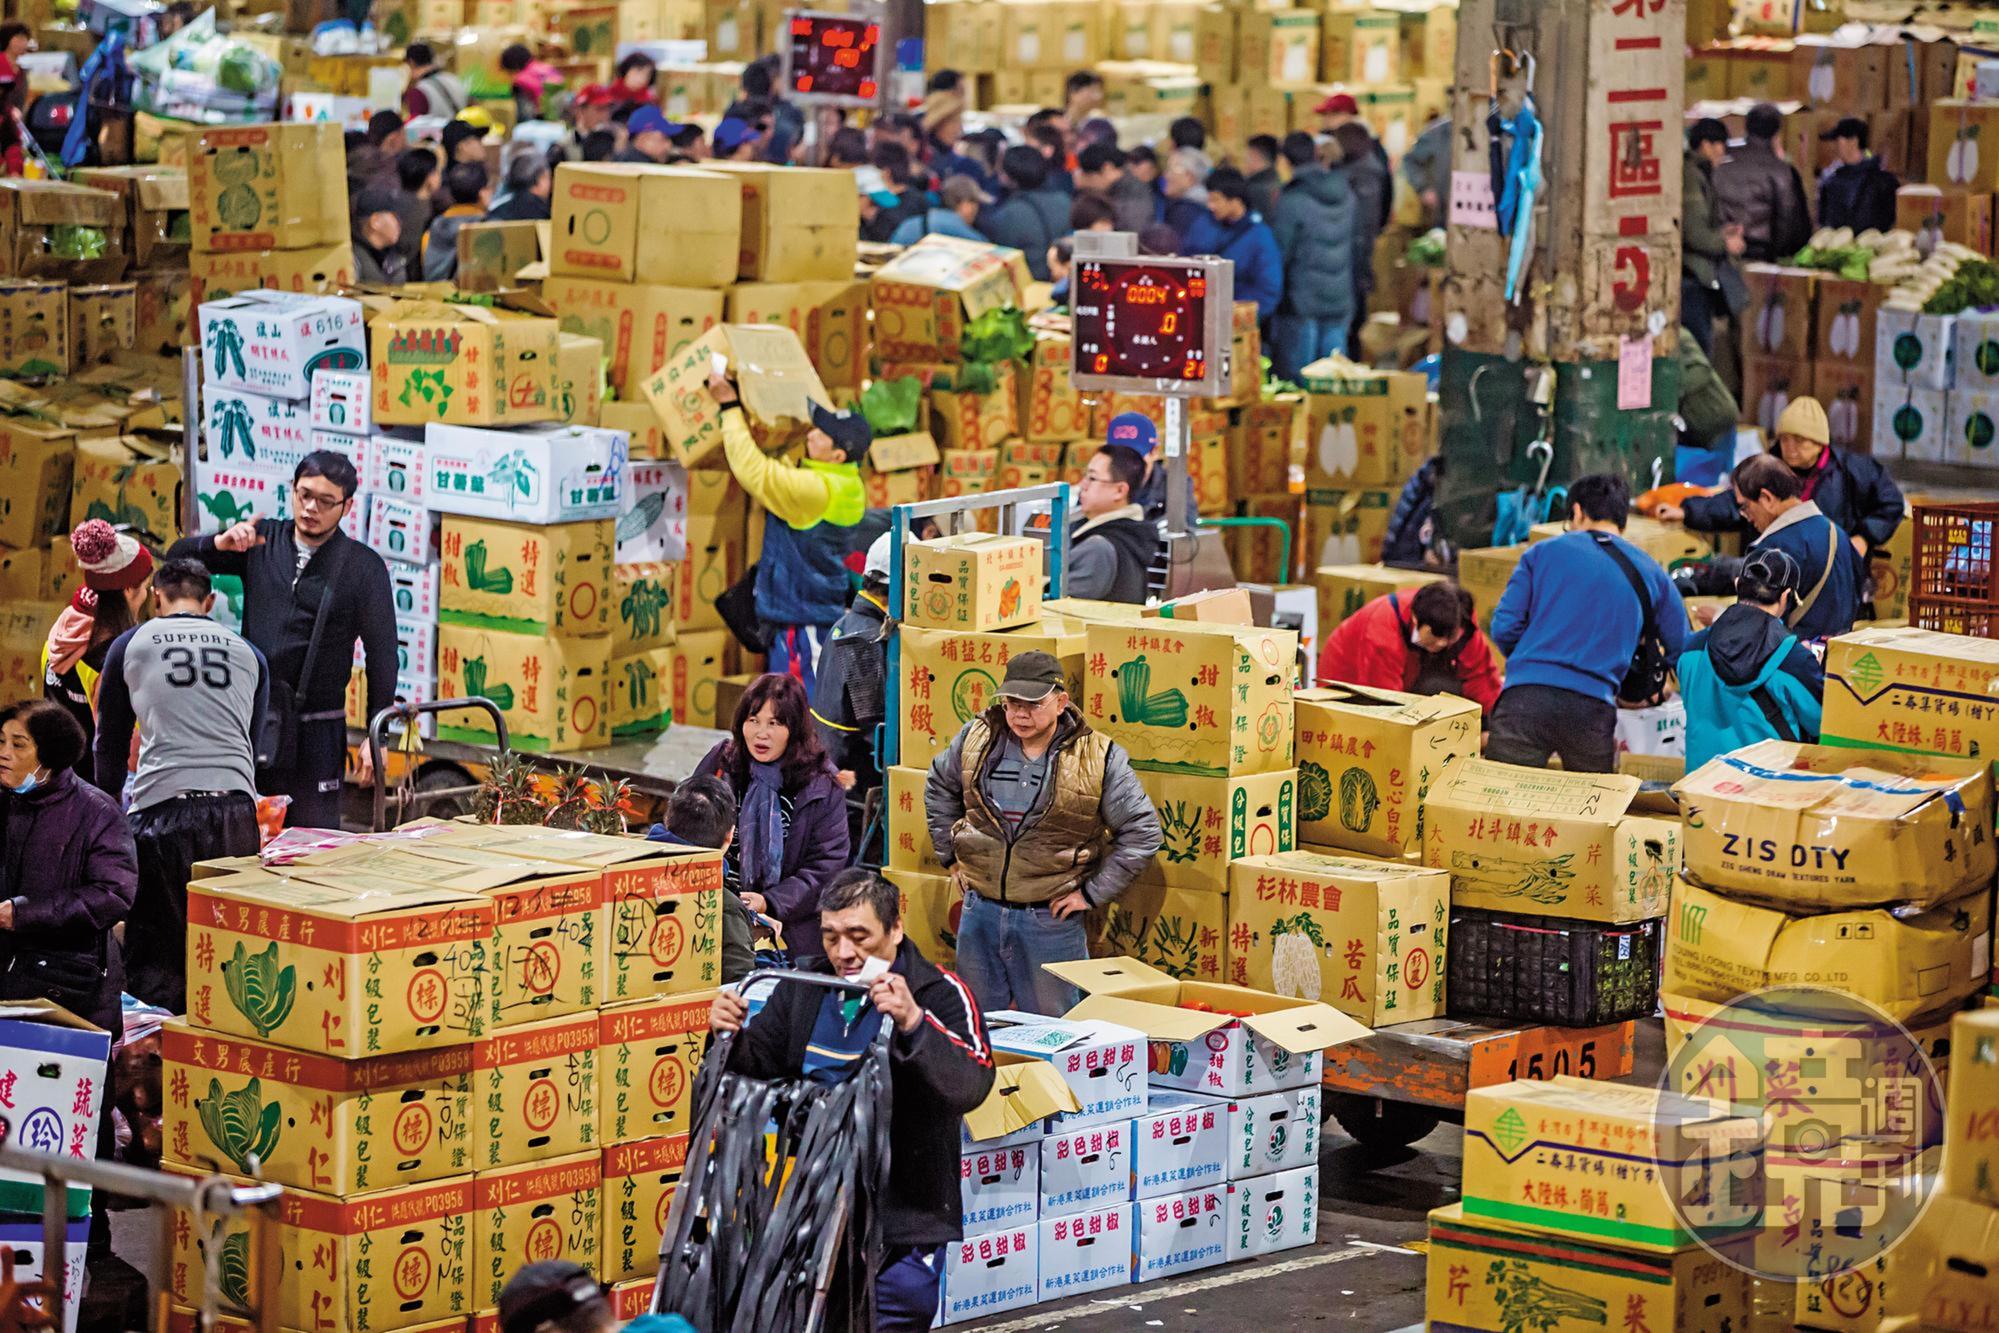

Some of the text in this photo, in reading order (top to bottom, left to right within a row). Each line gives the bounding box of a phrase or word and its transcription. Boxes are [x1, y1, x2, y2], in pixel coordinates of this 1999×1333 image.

[316, 314, 343, 335] 616
[152, 632, 232, 646] SUPPORT
[161, 646, 233, 691] 35
[1088, 652, 1109, 720] 特選
[1196, 662, 1221, 730] 甜椒
[910, 663, 937, 737] 精緻
[1301, 729, 1378, 761] 田中鎮農會
[1203, 805, 1224, 860] 新鮮
[1385, 766, 1405, 845] 包心白菜
[1466, 816, 1559, 849] 北斗鎮農會
[1584, 843, 1605, 908] 芹菜
[1722, 832, 1850, 871] ZIS DTY
[613, 873, 647, 895] 刈仁
[1255, 873, 1343, 914] 杉林農會
[360, 924, 398, 950] 刈仁
[1200, 924, 1220, 979] 新鮮
[1230, 922, 1252, 988] 特選
[195, 931, 215, 1027] 特選
[1339, 938, 1368, 1004] 苦瓜
[321, 956, 346, 1051] 刈仁
[365, 951, 384, 1052] 分級包裝
[612, 1015, 646, 1041] 刈仁
[485, 1038, 519, 1066] 刈仁
[1066, 1043, 1136, 1074] 彩色甜椒
[1208, 1052, 1225, 1089] 甜椒
[169, 1067, 193, 1162] 特選
[487, 1065, 505, 1166] 分級包裝
[615, 1042, 632, 1139] 分級包裝
[69, 1076, 94, 1161] 蔬菜
[307, 1094, 335, 1189] 刈仁
[354, 1088, 374, 1190] 分級包裝
[1056, 1129, 1120, 1161] 彩色甜椒
[1151, 1111, 1216, 1140] 彩色甜椒
[1242, 1106, 1256, 1168] 分級包裝
[615, 1147, 650, 1174] 刈仁
[352, 1204, 386, 1231] 刈仁
[487, 1177, 522, 1204] 刈仁
[1154, 1193, 1217, 1224] 彩色甜椒
[1239, 1186, 1253, 1250] 分級包裝
[619, 1173, 638, 1274] 分級包裝
[961, 1232, 1027, 1265] 彩色甜椒
[1054, 1211, 1120, 1242] 彩色甜椒
[311, 1237, 338, 1331] 刈仁
[355, 1231, 374, 1332] 分級包裝
[449, 1214, 466, 1312] 品質保證
